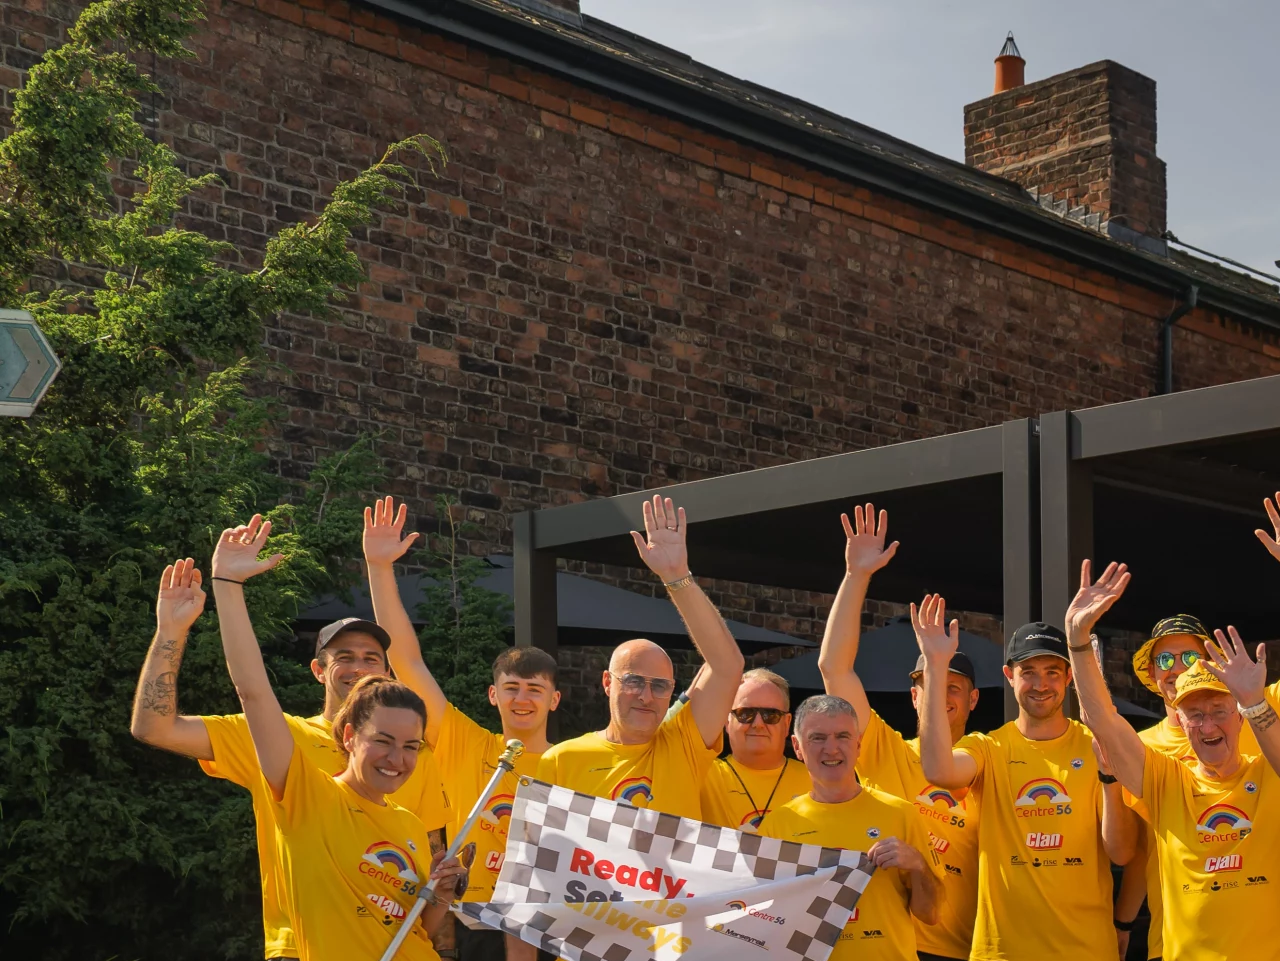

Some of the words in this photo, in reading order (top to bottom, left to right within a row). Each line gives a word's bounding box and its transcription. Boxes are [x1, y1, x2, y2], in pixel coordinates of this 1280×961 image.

[1015, 805, 1055, 818] Centre
[1056, 804, 1072, 815] 56
[949, 815, 966, 828] 56
[1026, 833, 1060, 847] Clan
[1198, 830, 1238, 843] Centre
[1204, 854, 1240, 872] Clan
[358, 861, 402, 888] Centre
[400, 880, 417, 896] 56
[570, 847, 695, 899] Ready.
[748, 908, 775, 923] Centre
[773, 916, 785, 925] 56
[725, 928, 766, 947] Merseyrail
